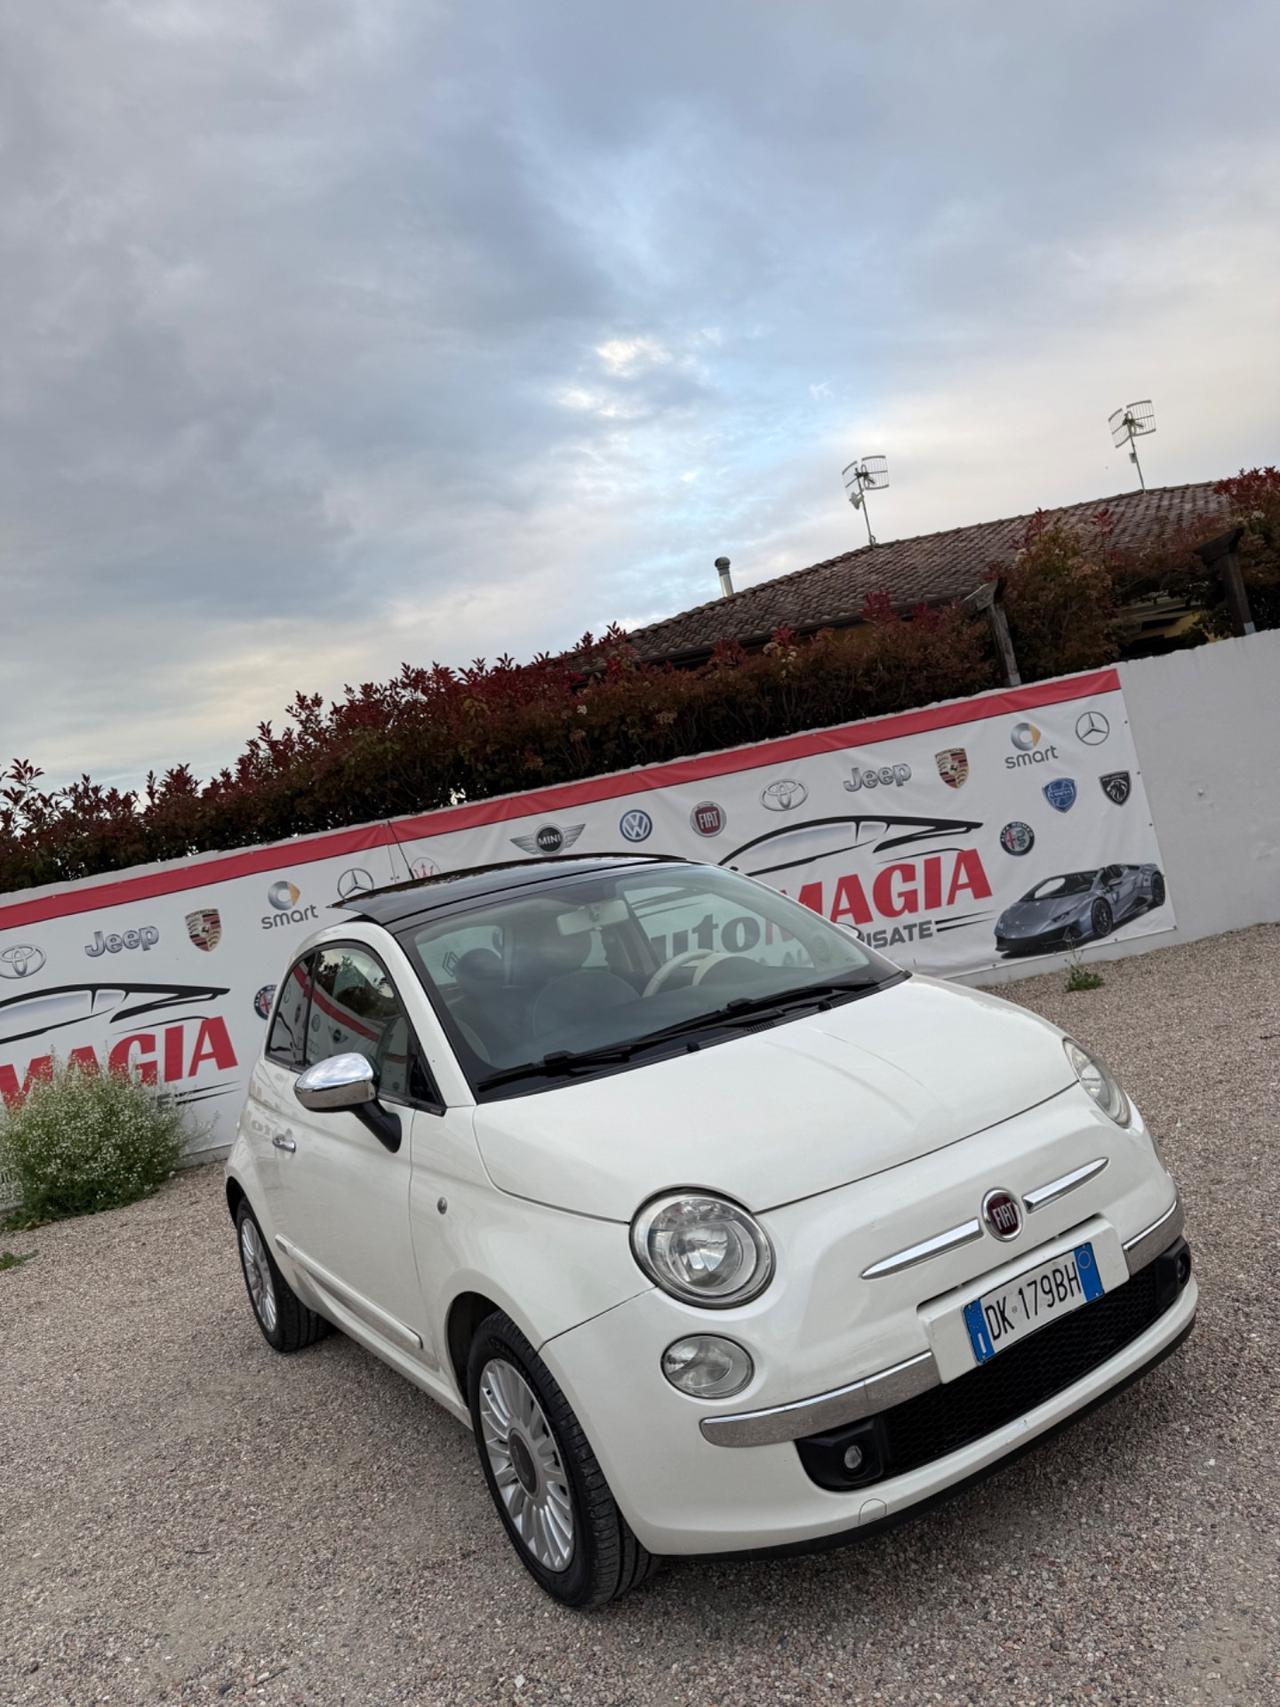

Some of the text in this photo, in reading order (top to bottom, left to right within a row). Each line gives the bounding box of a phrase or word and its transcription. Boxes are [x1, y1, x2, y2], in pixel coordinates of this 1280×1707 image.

[1004, 745, 1059, 769] smart
[843, 762, 912, 792] Jeep
[699, 811, 720, 830] FIAT
[537, 832, 562, 846] MINI
[261, 903, 319, 930] smart
[84, 925, 160, 958] Jeep
[992, 1201, 1017, 1231] FIAT
